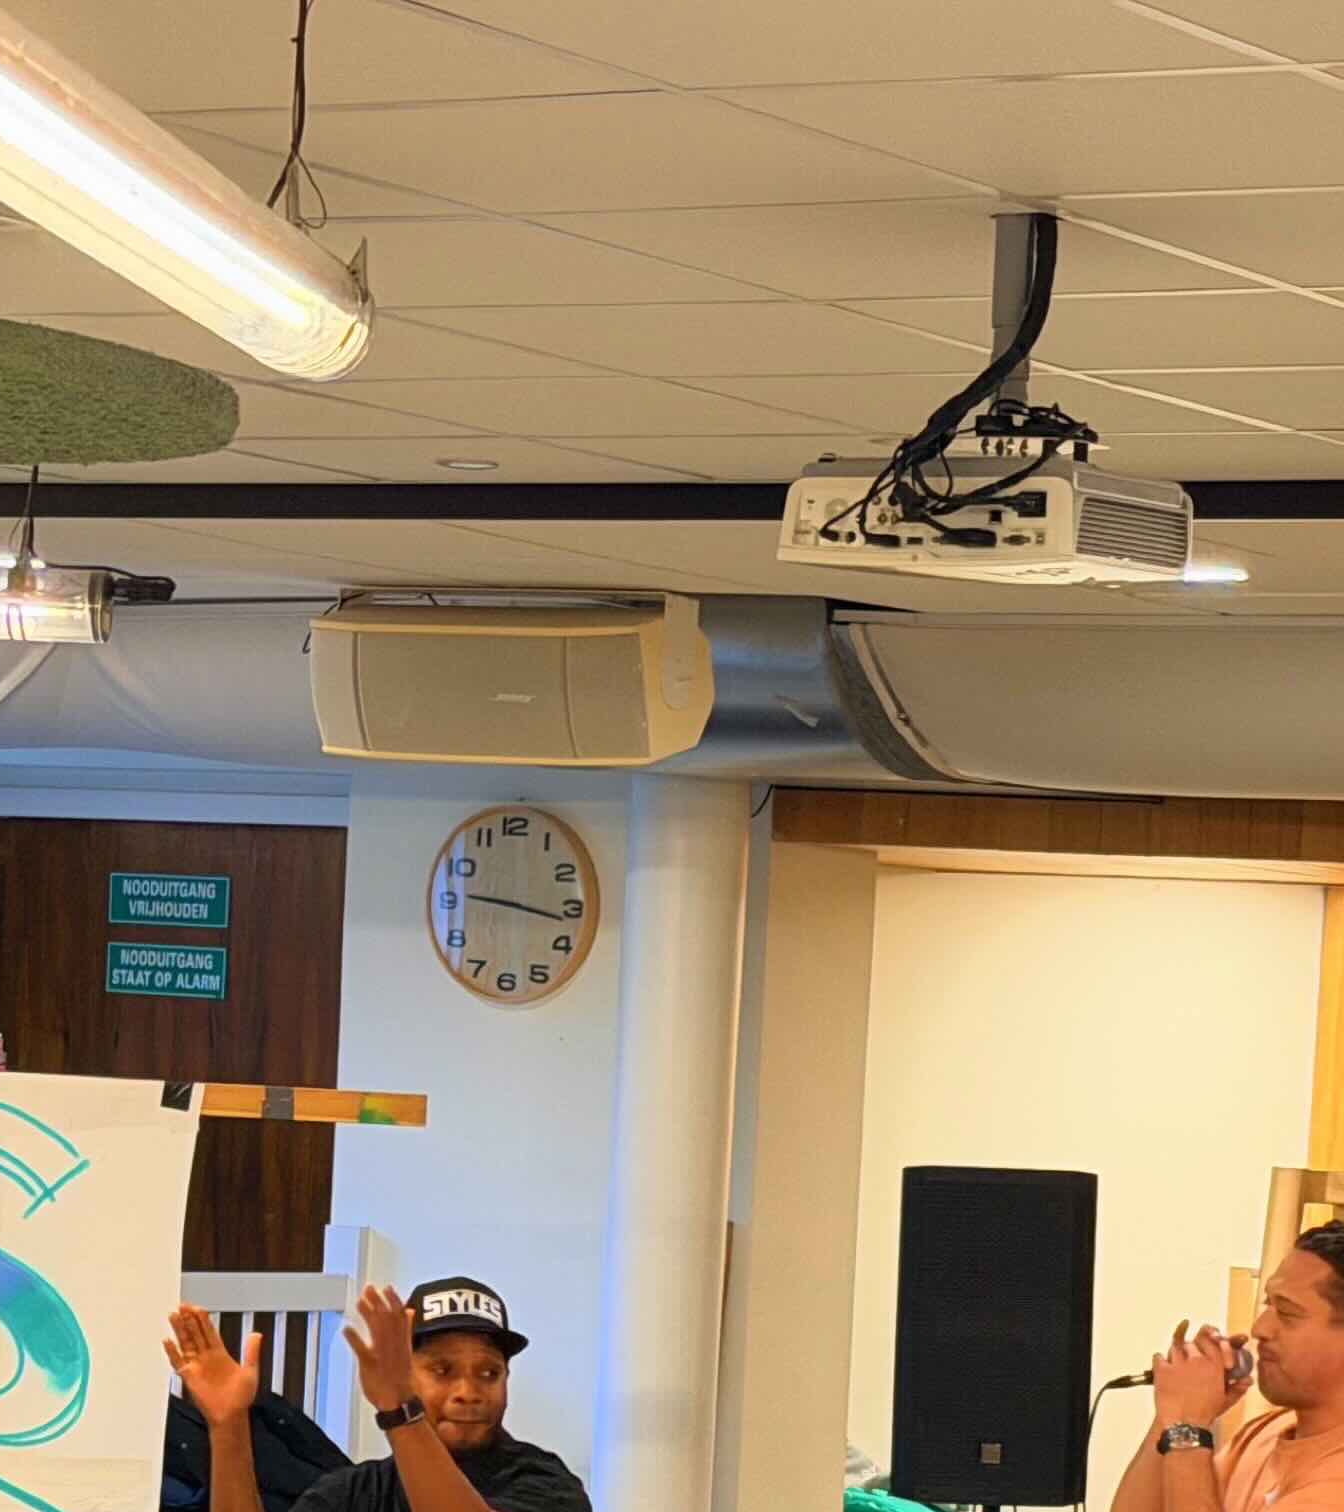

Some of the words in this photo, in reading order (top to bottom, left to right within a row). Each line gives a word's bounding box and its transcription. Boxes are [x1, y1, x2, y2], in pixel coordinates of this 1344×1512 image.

[502, 817, 528, 836] 12
[476, 828, 492, 847] 11
[543, 832, 551, 851] 1
[448, 858, 476, 878] 10
[554, 863, 576, 882] 2
[123, 879, 216, 899] NOODUITGANG
[129, 899, 208, 919] VRIJHOUDEN
[440, 891, 458, 910] 9
[563, 899, 584, 919] 3
[447, 929, 466, 948] 8
[552, 935, 572, 955] 4
[120, 949, 213, 970] NOODUITGANG
[467, 959, 487, 979] 7
[112, 968, 152, 987] STAAT
[154, 971, 172, 988] OP
[176, 973, 221, 991] ALARM
[496, 973, 516, 992] 6
[529, 964, 550, 984] 5
[422, 1288, 504, 1329] STYLES
